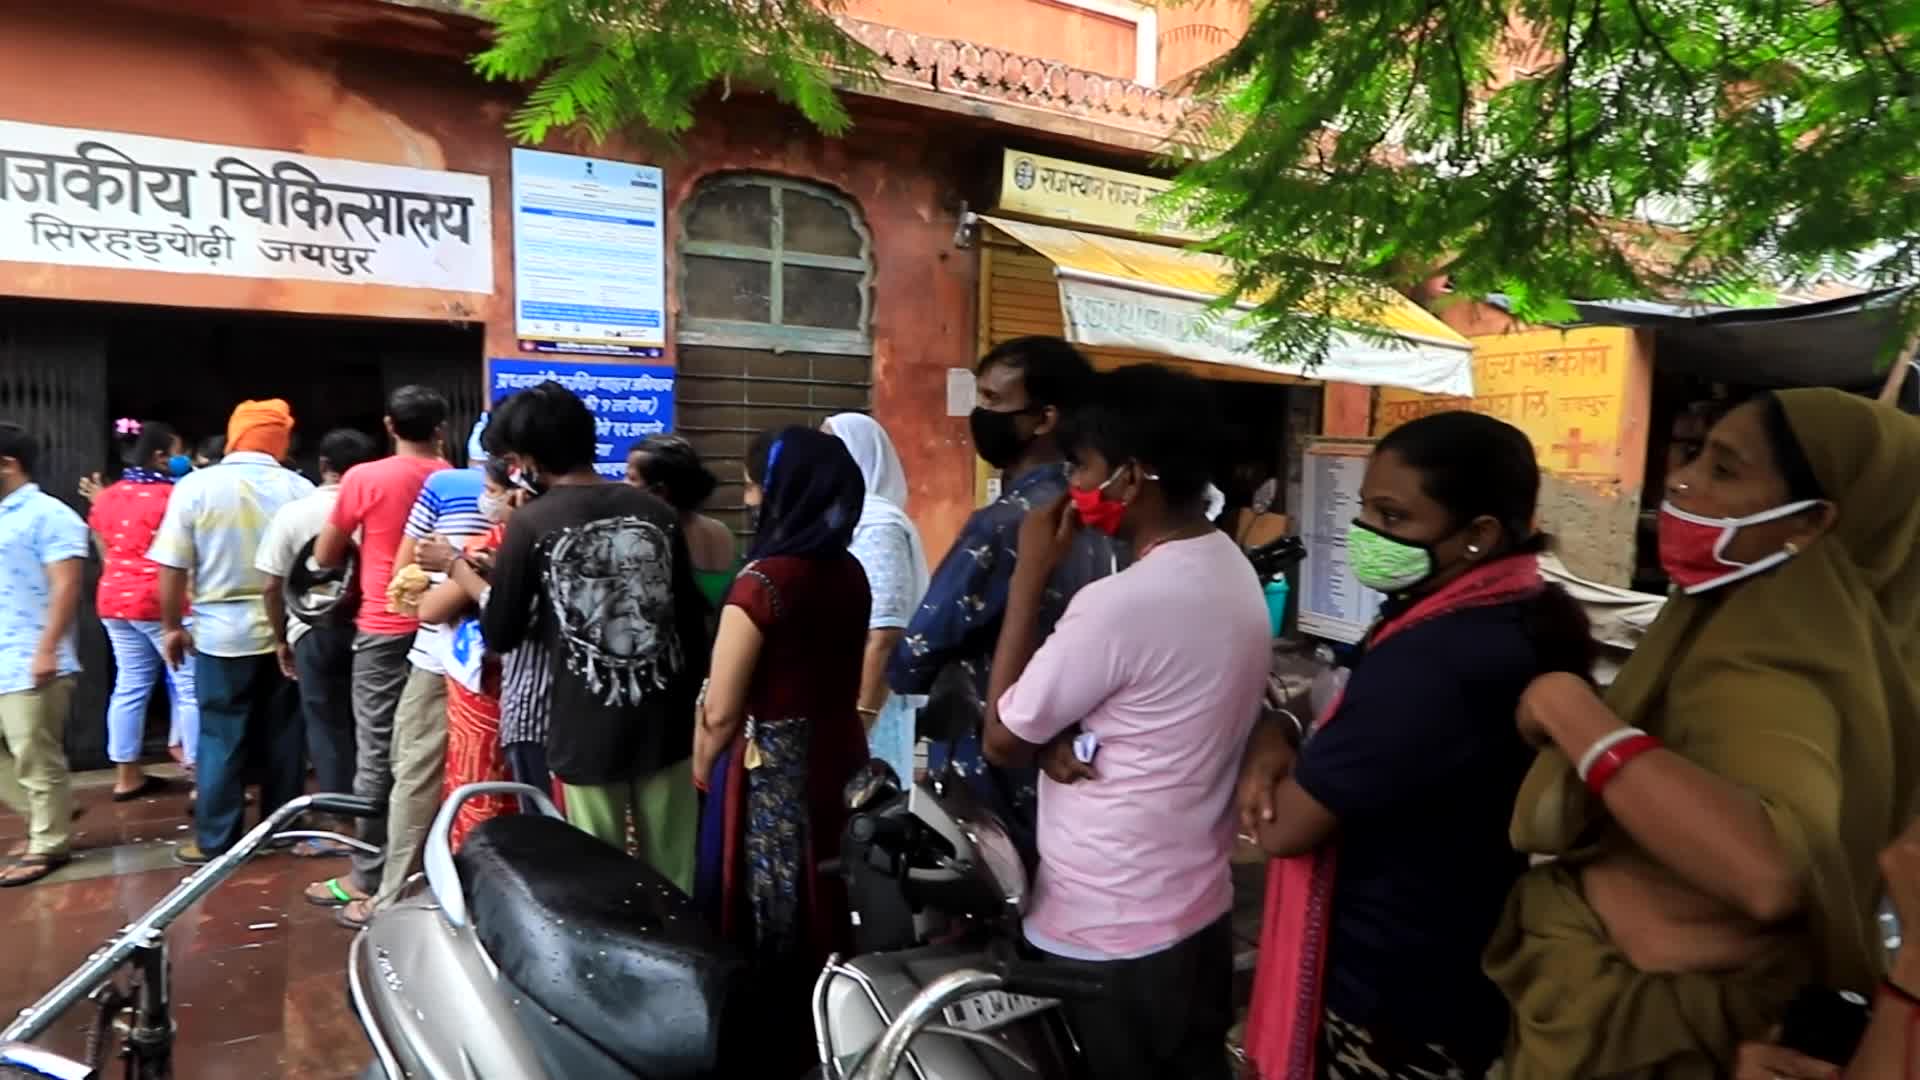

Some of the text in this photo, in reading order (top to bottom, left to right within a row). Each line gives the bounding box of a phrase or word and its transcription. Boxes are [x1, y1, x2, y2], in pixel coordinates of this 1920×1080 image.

[0, 141, 475, 247] ाजकीय चिकित्सालय
[1038, 167, 1105, 200] राजस्थान
[257, 238, 377, 275] जयपुर
